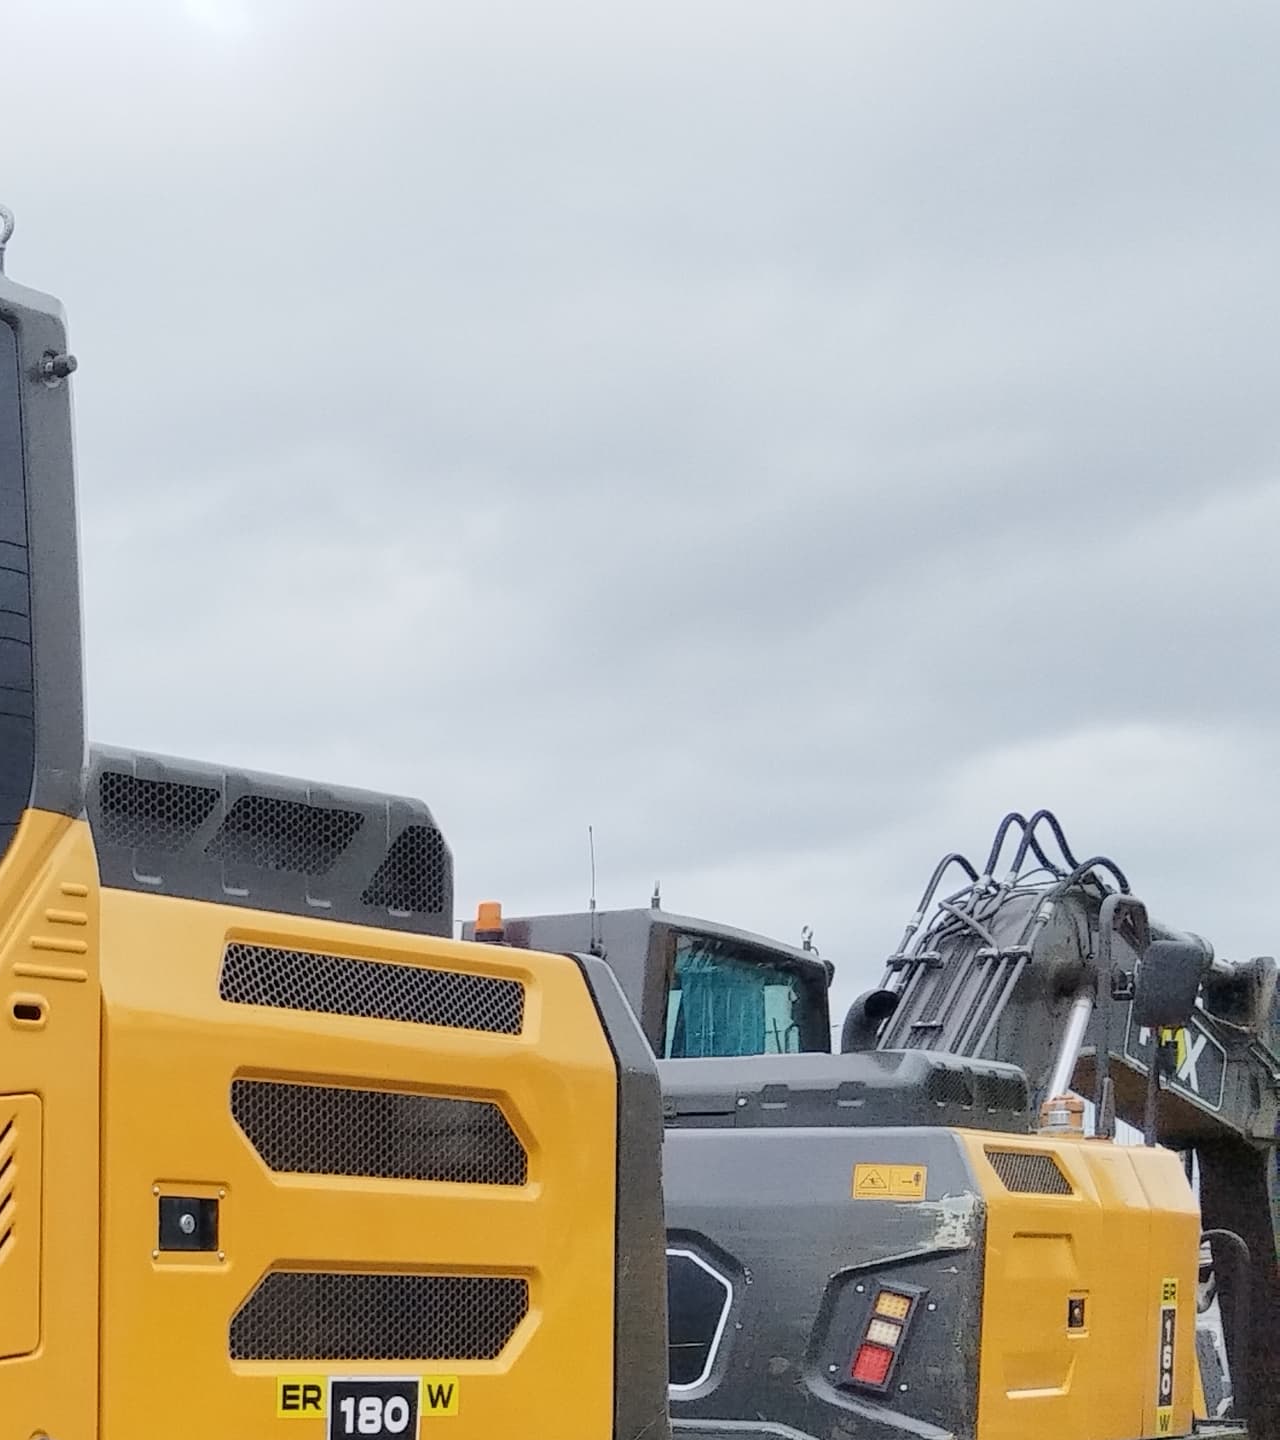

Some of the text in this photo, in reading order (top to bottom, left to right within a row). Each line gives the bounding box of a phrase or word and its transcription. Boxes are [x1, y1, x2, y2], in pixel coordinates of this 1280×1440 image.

[282, 1383, 454, 1434] ER 180 W
